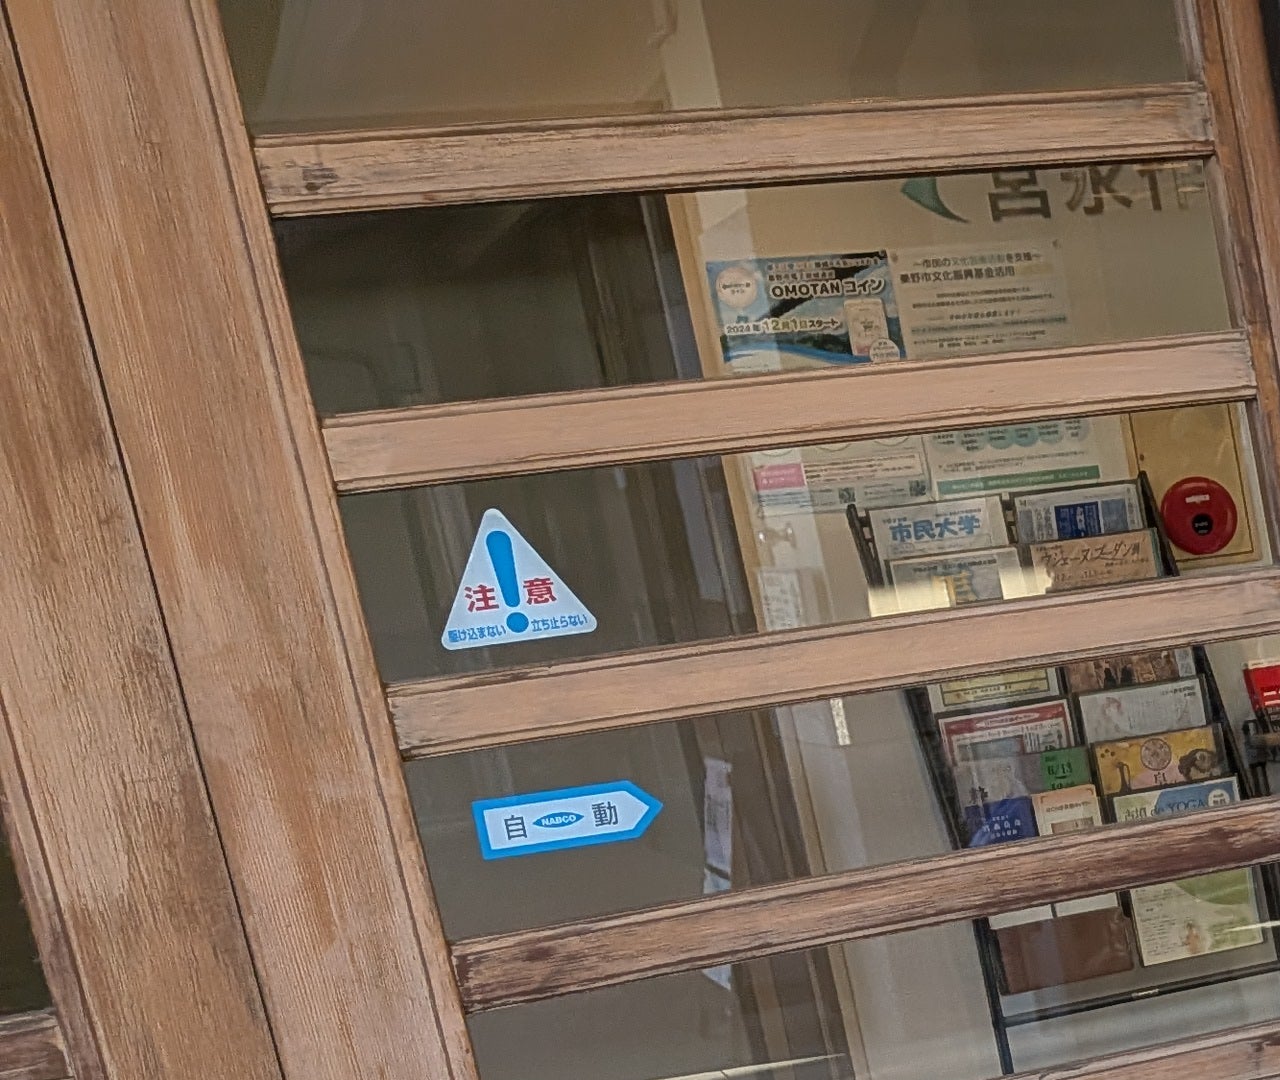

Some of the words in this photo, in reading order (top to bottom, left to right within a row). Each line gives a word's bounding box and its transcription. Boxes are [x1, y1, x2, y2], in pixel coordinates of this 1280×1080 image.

[771, 281, 840, 298] OMOTAN
[844, 279, 883, 294] コイン
[889, 515, 981, 543] 市民大学
[463, 584, 500, 613] 注
[522, 577, 557, 606] 意
[447, 624, 507, 644] 駆け込まない
[504, 814, 528, 841] 自
[541, 814, 576, 827] NABCO
[591, 801, 620, 829] 動
